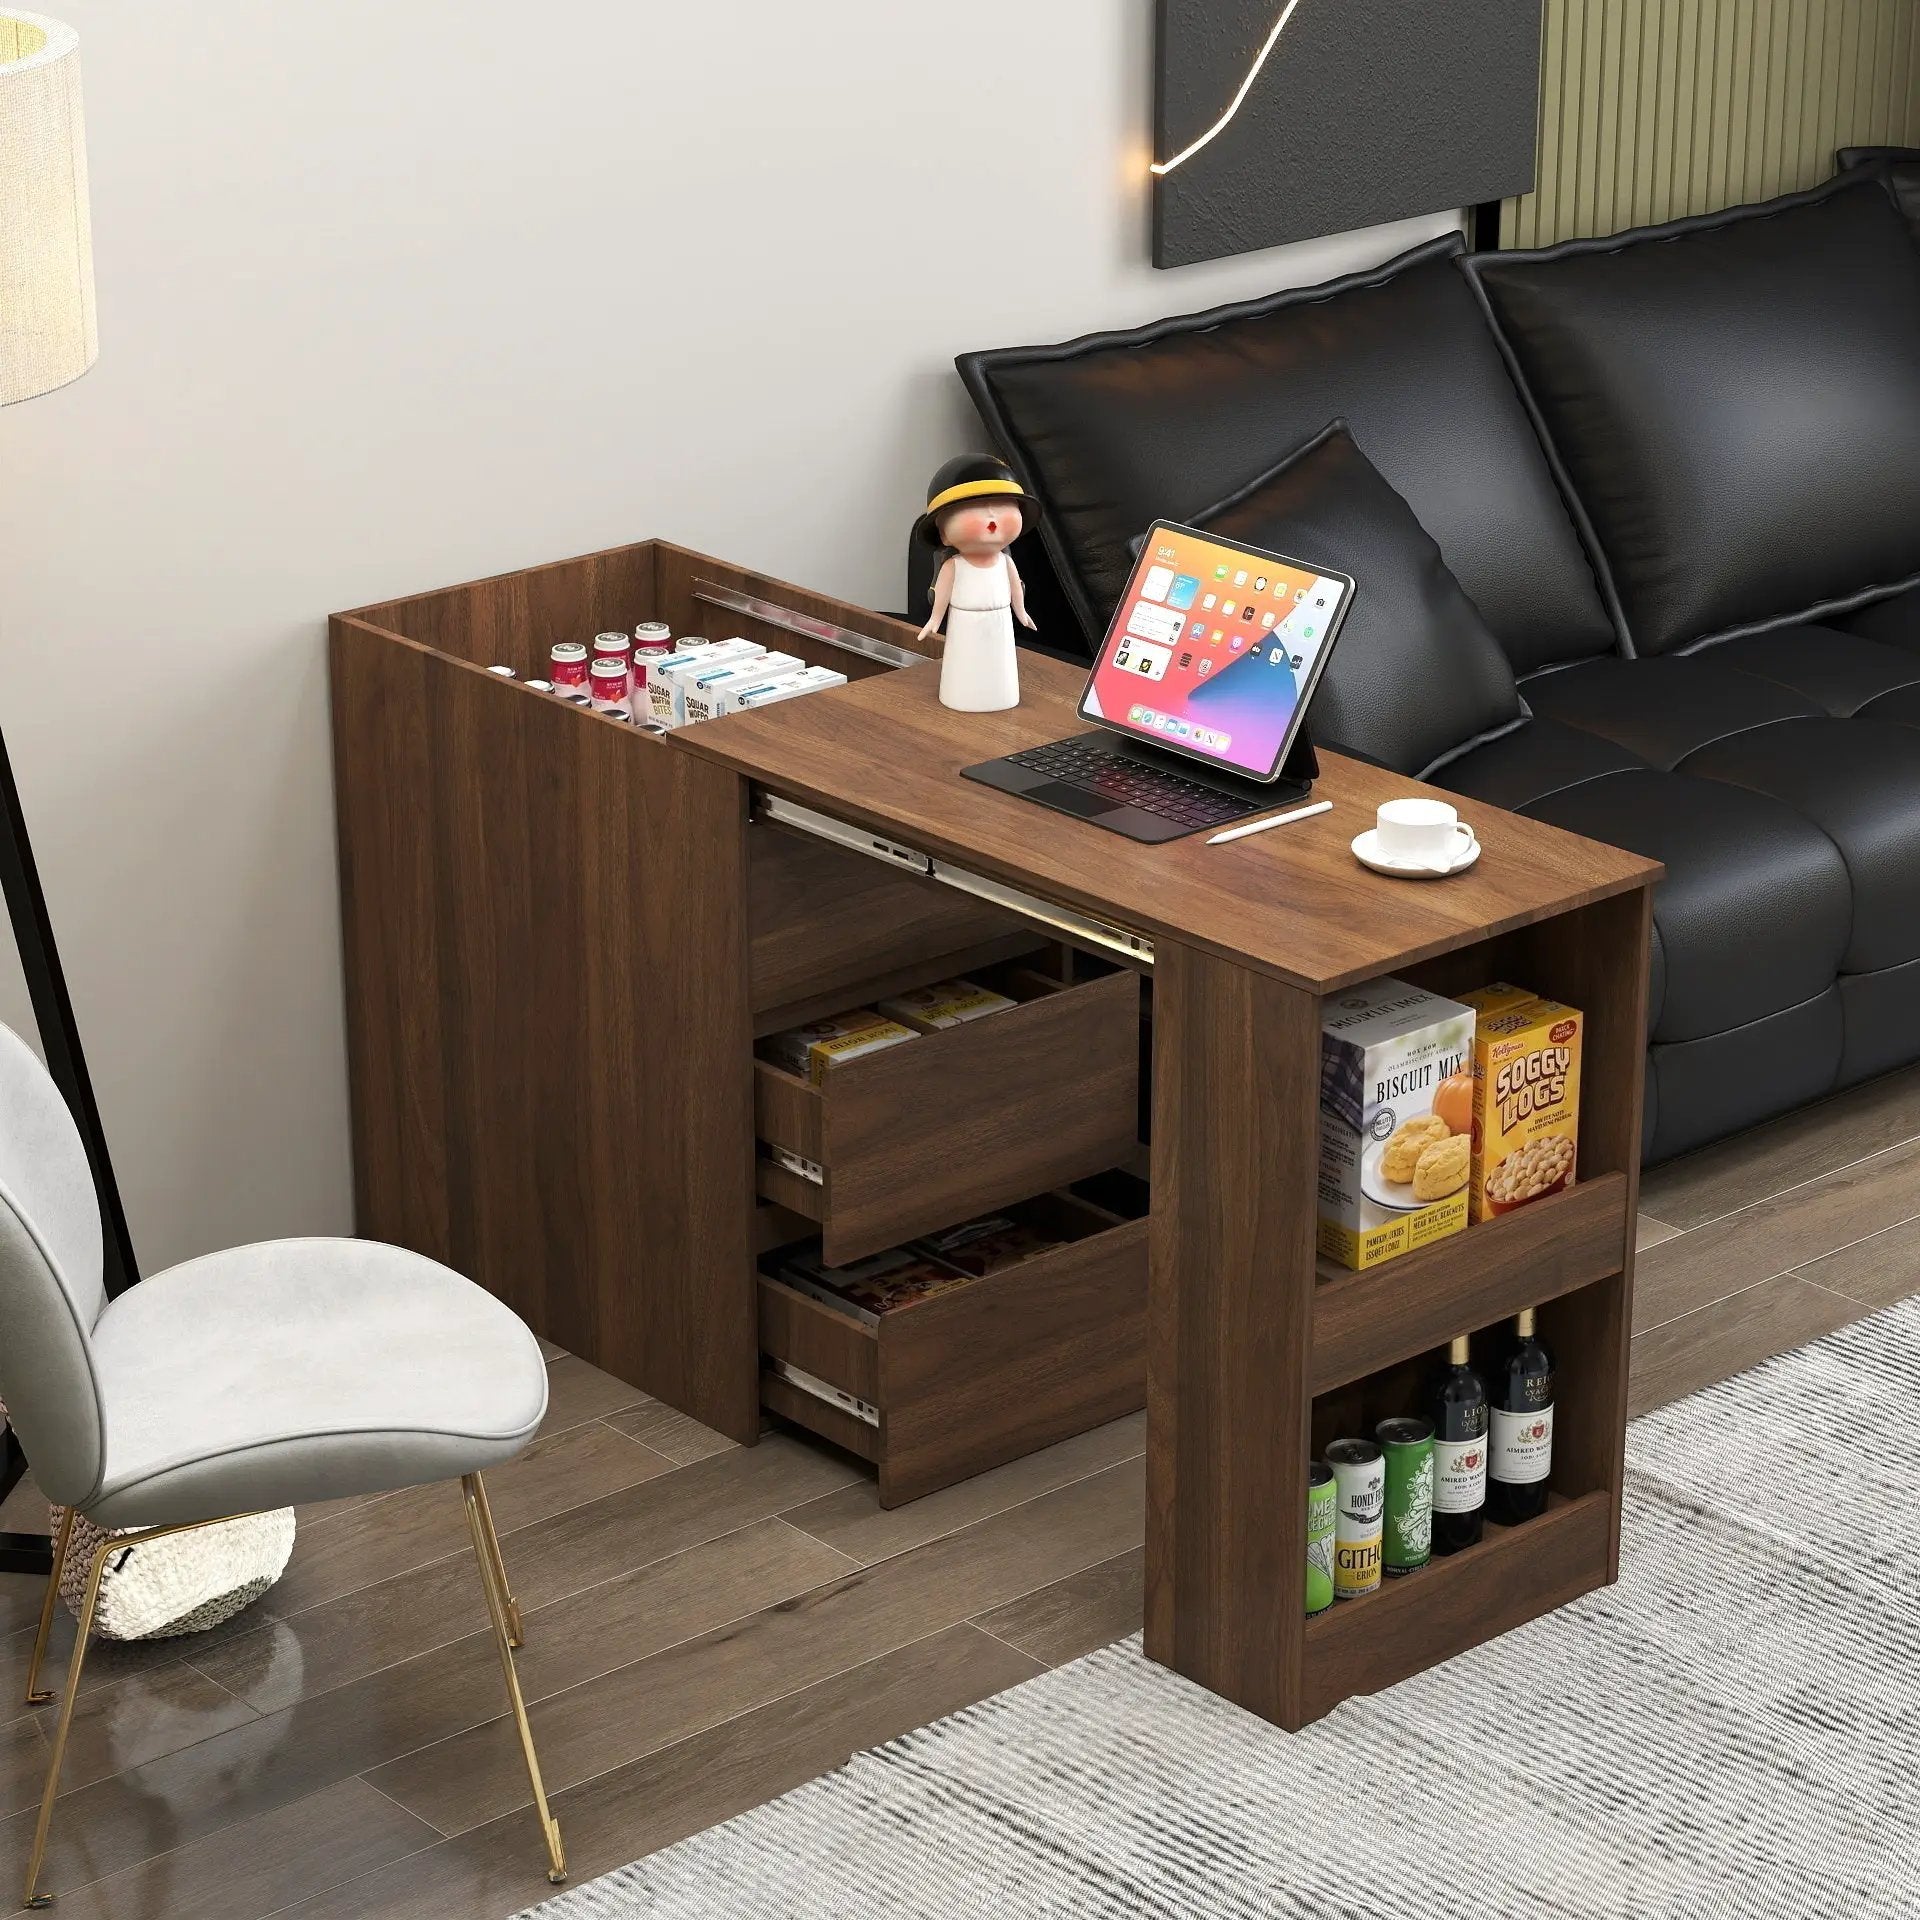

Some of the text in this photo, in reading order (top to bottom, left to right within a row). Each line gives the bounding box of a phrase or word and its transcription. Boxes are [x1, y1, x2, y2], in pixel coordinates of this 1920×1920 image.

[647, 681, 671, 699] SUGAR
[686, 696, 709, 714] SQUAR
[653, 703, 673, 716] BITES
[1376, 1064, 1432, 1104] BISCUIT
[1438, 1052, 1464, 1082] MIX
[1496, 1047, 1571, 1108] SOGGY
[1501, 1075, 1567, 1137] LOGS
